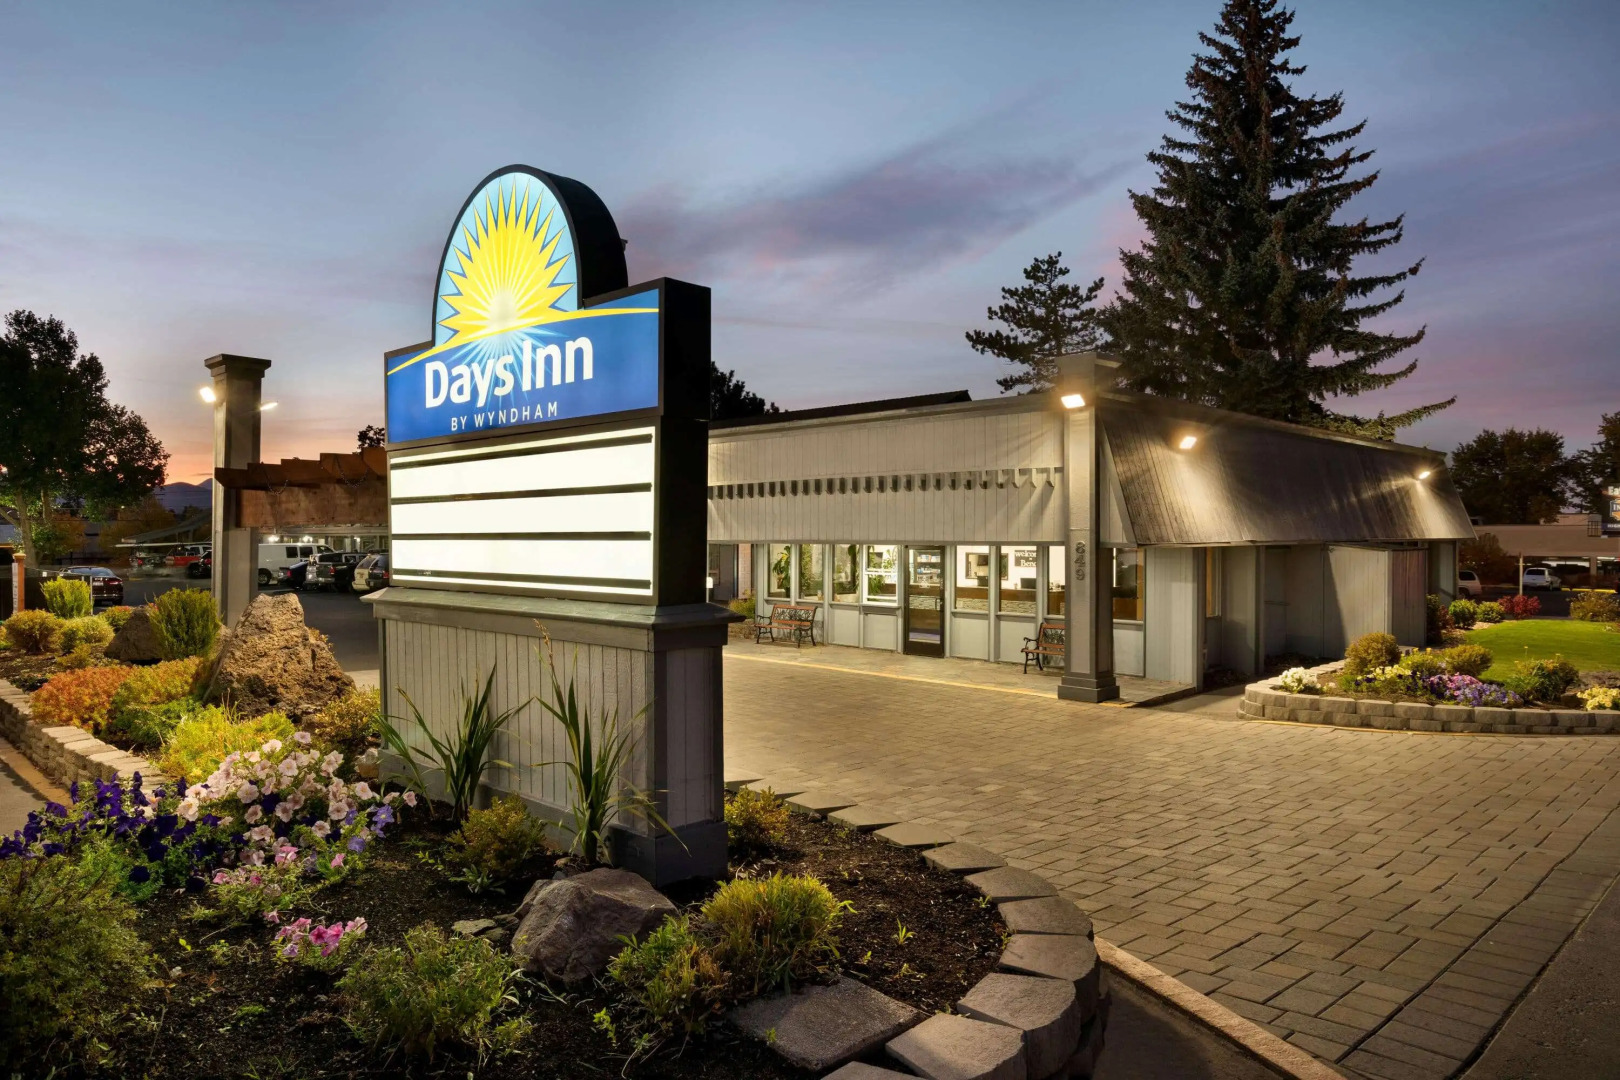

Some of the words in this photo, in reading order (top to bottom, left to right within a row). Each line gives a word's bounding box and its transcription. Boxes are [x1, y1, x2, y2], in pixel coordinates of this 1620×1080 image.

[425, 355, 515, 408] Days
[522, 336, 594, 392] Inn
[451, 416, 467, 431] BY
[474, 401, 558, 428] WYNDHAM
[1608, 486, 1620, 496] Ea
